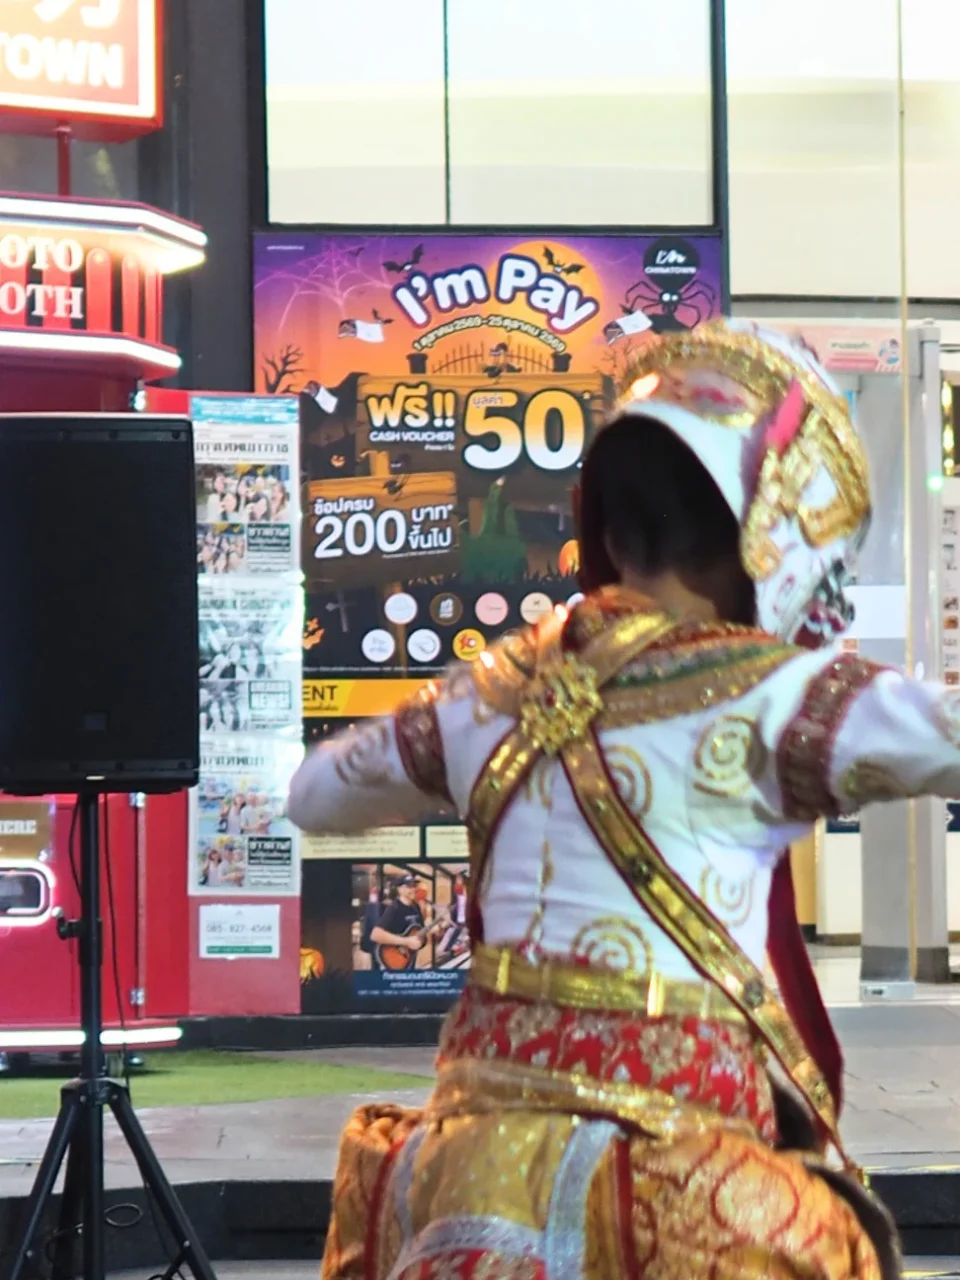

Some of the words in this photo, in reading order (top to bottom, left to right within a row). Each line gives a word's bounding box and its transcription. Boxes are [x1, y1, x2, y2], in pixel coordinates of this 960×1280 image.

[499, 258, 596, 331] Pay
[370, 431, 402, 441] CASH
[402, 431, 455, 441] VOUCHER
[314, 509, 406, 559] 200
[408, 525, 452, 550] ขึ้นไป
